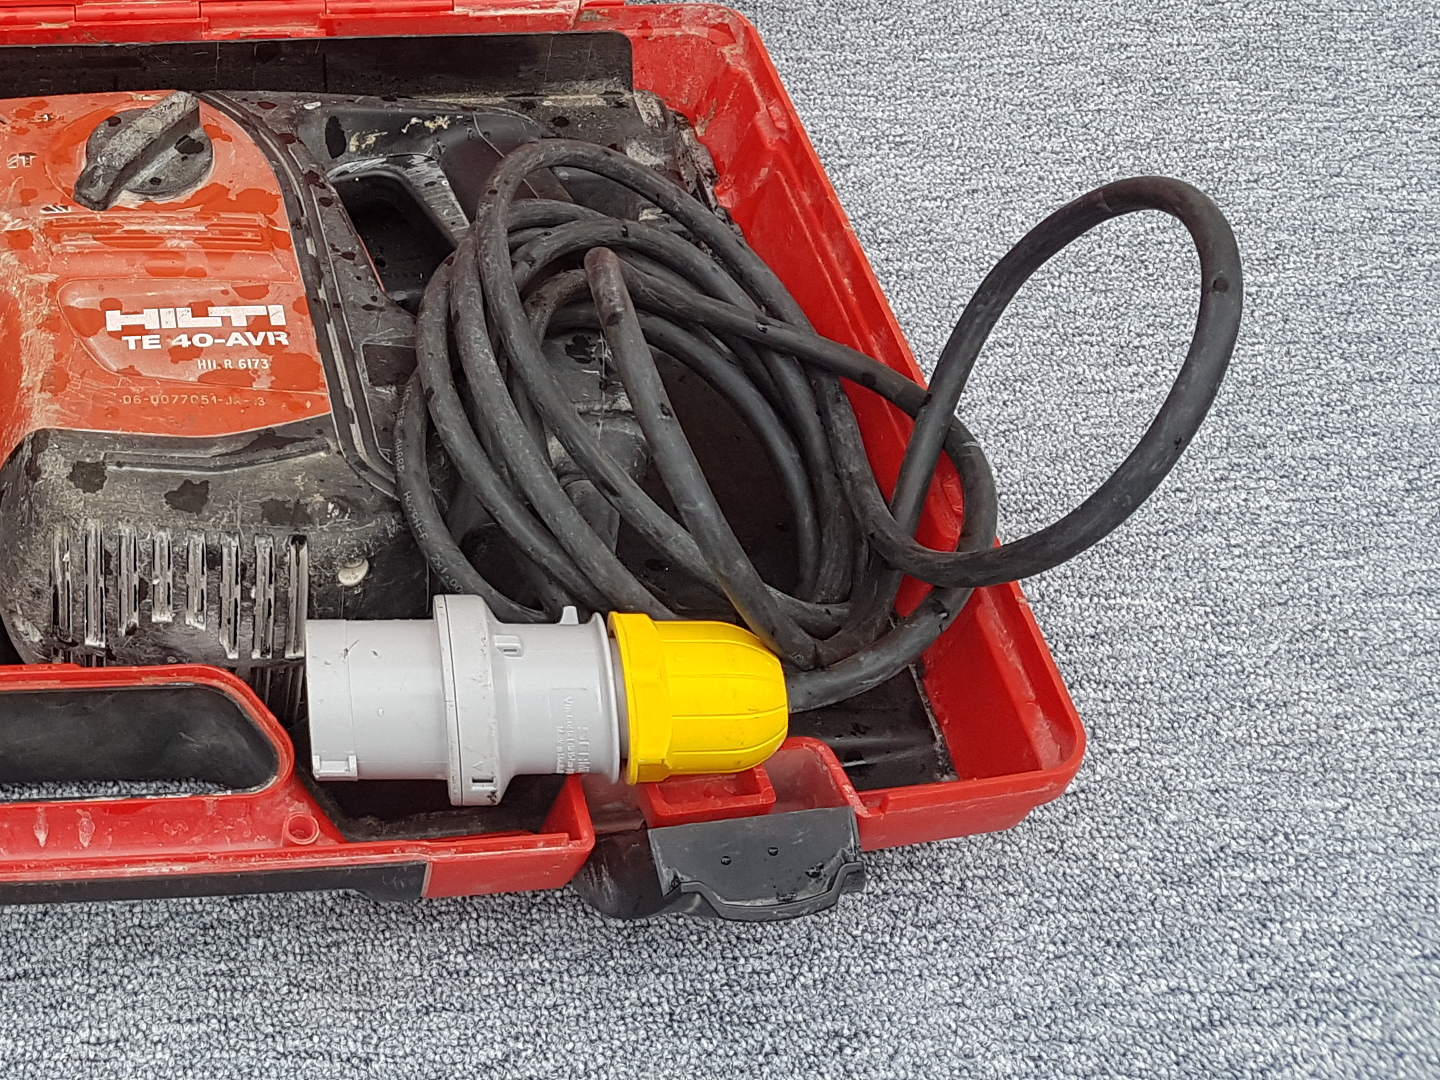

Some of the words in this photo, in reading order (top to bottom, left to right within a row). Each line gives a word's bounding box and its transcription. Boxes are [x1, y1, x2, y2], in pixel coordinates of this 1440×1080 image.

[106, 305, 286, 331] HILTI
[122, 334, 161, 350] TE
[172, 332, 289, 348] 40-AVR
[226, 360, 233, 369] R
[239, 359, 269, 369] 6173
